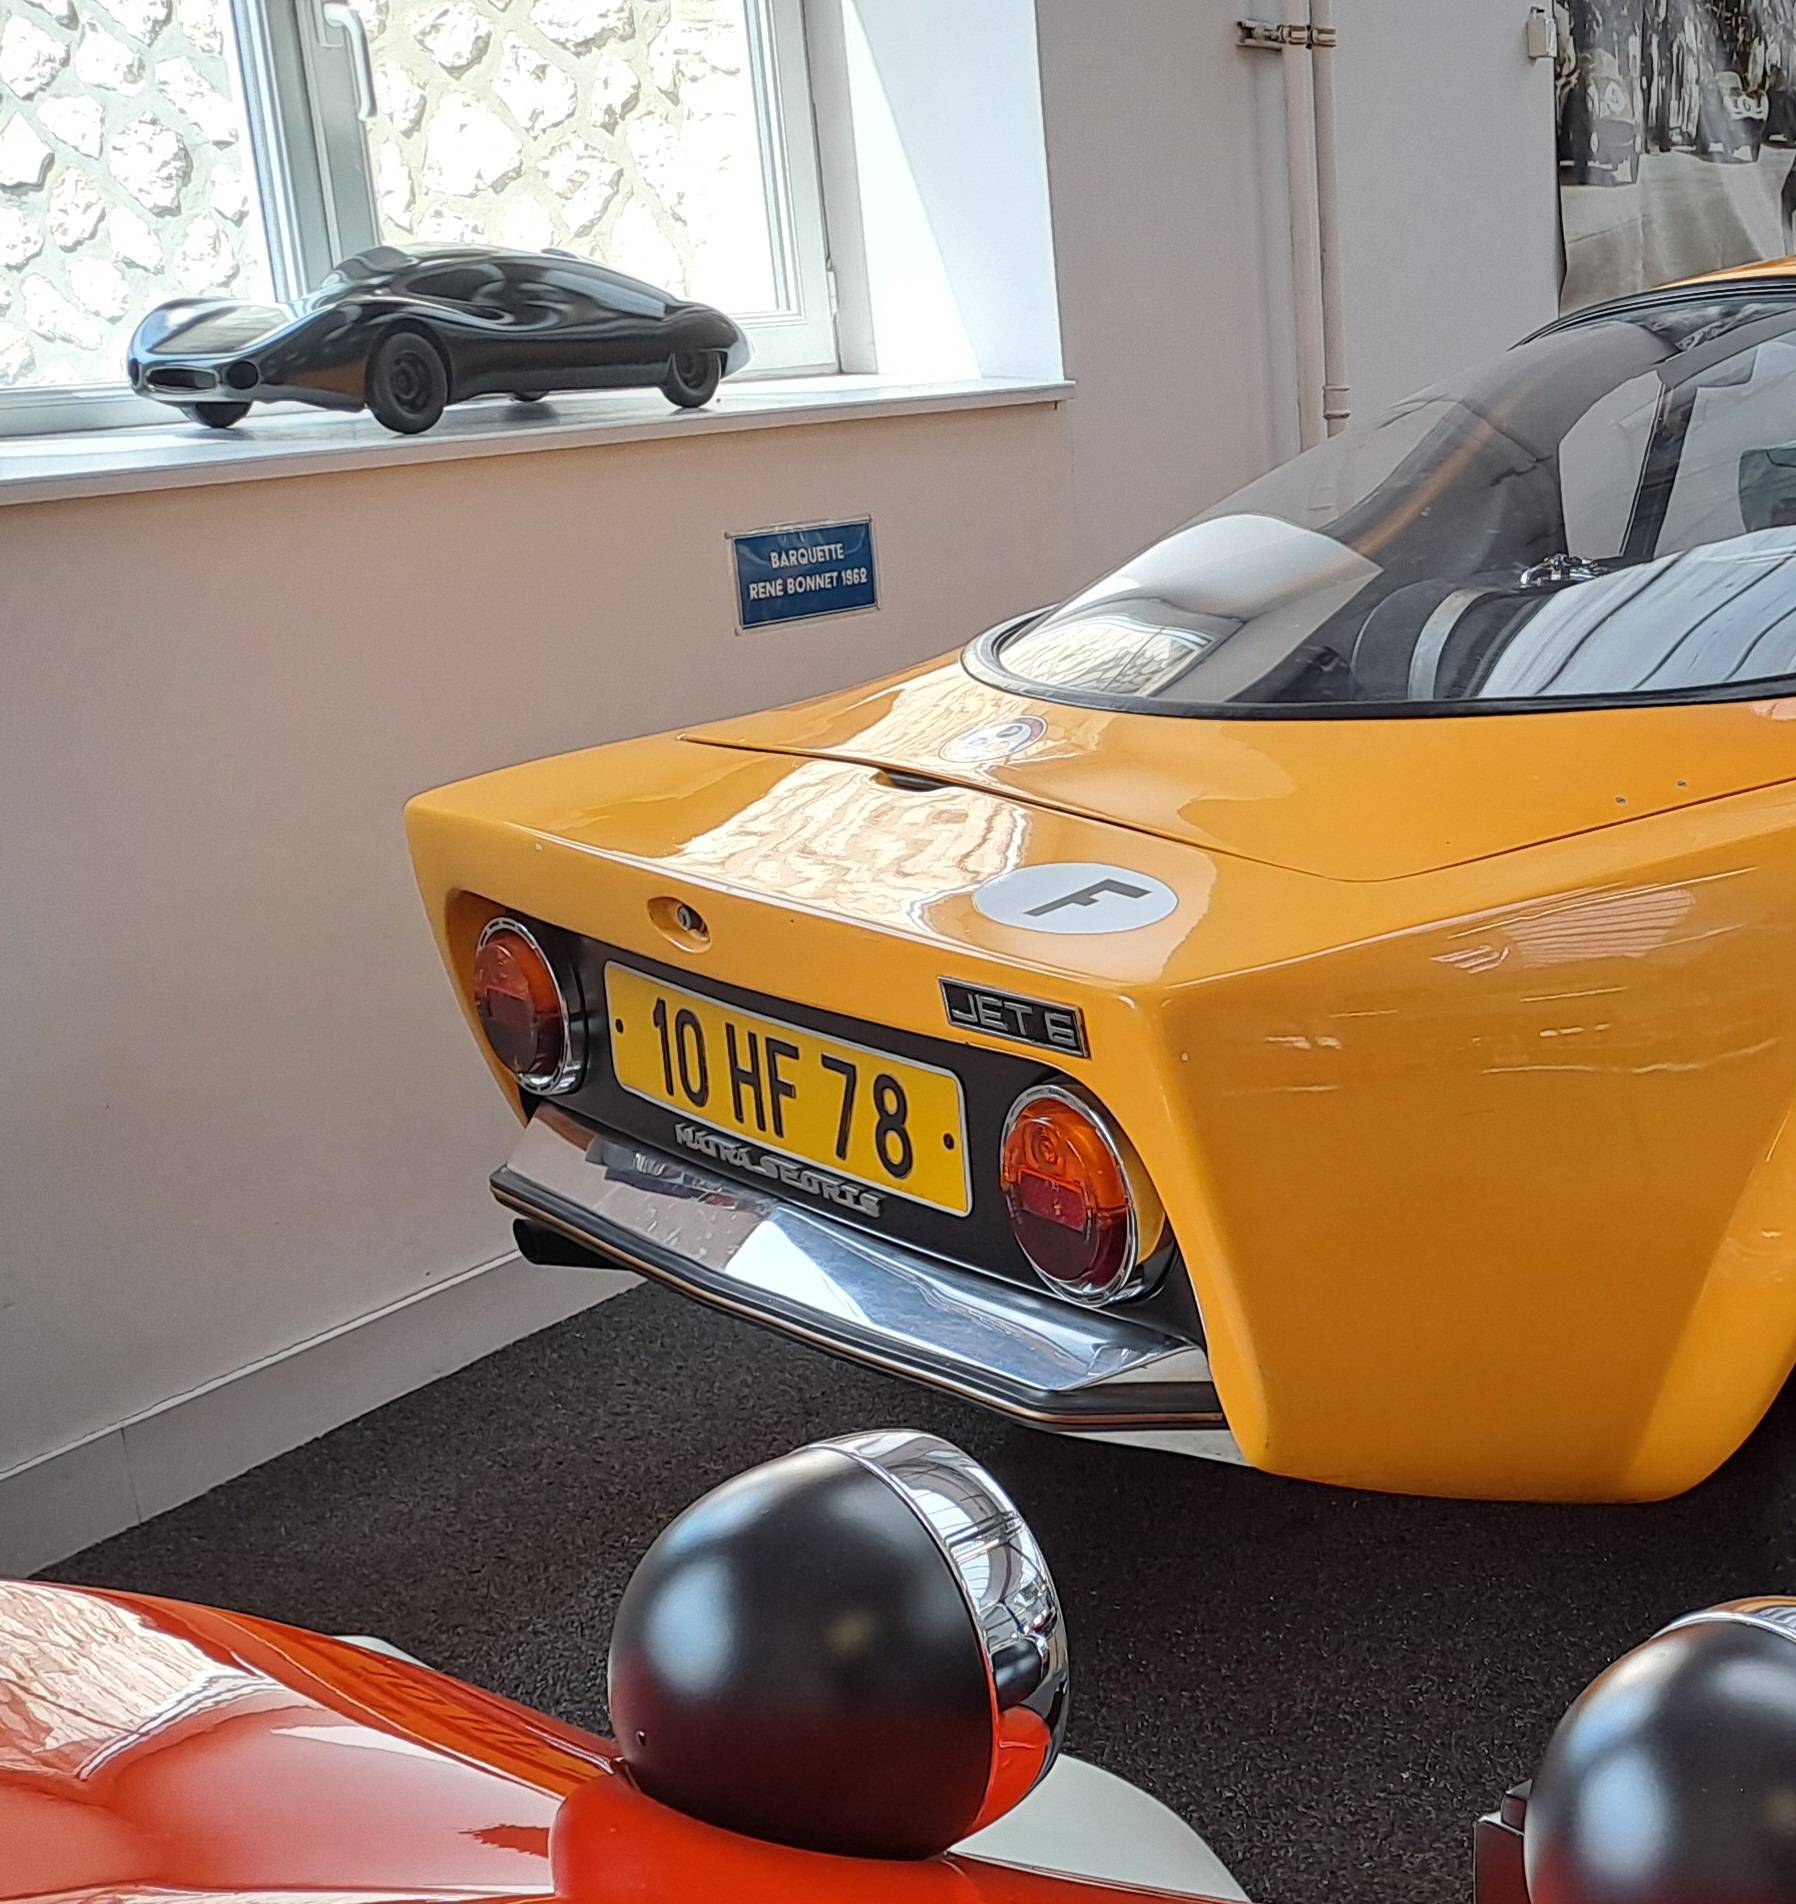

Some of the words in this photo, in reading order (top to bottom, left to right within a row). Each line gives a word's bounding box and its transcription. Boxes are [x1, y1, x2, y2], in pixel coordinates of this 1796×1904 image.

[770, 543, 844, 568] BARQUETTE
[787, 571, 838, 594] BONNET
[1022, 878, 1152, 917] F
[952, 993, 1033, 1036] JET
[1044, 1012, 1077, 1047] 6
[653, 997, 708, 1108] 10
[725, 1022, 800, 1138] HF
[820, 1054, 914, 1179] 78
